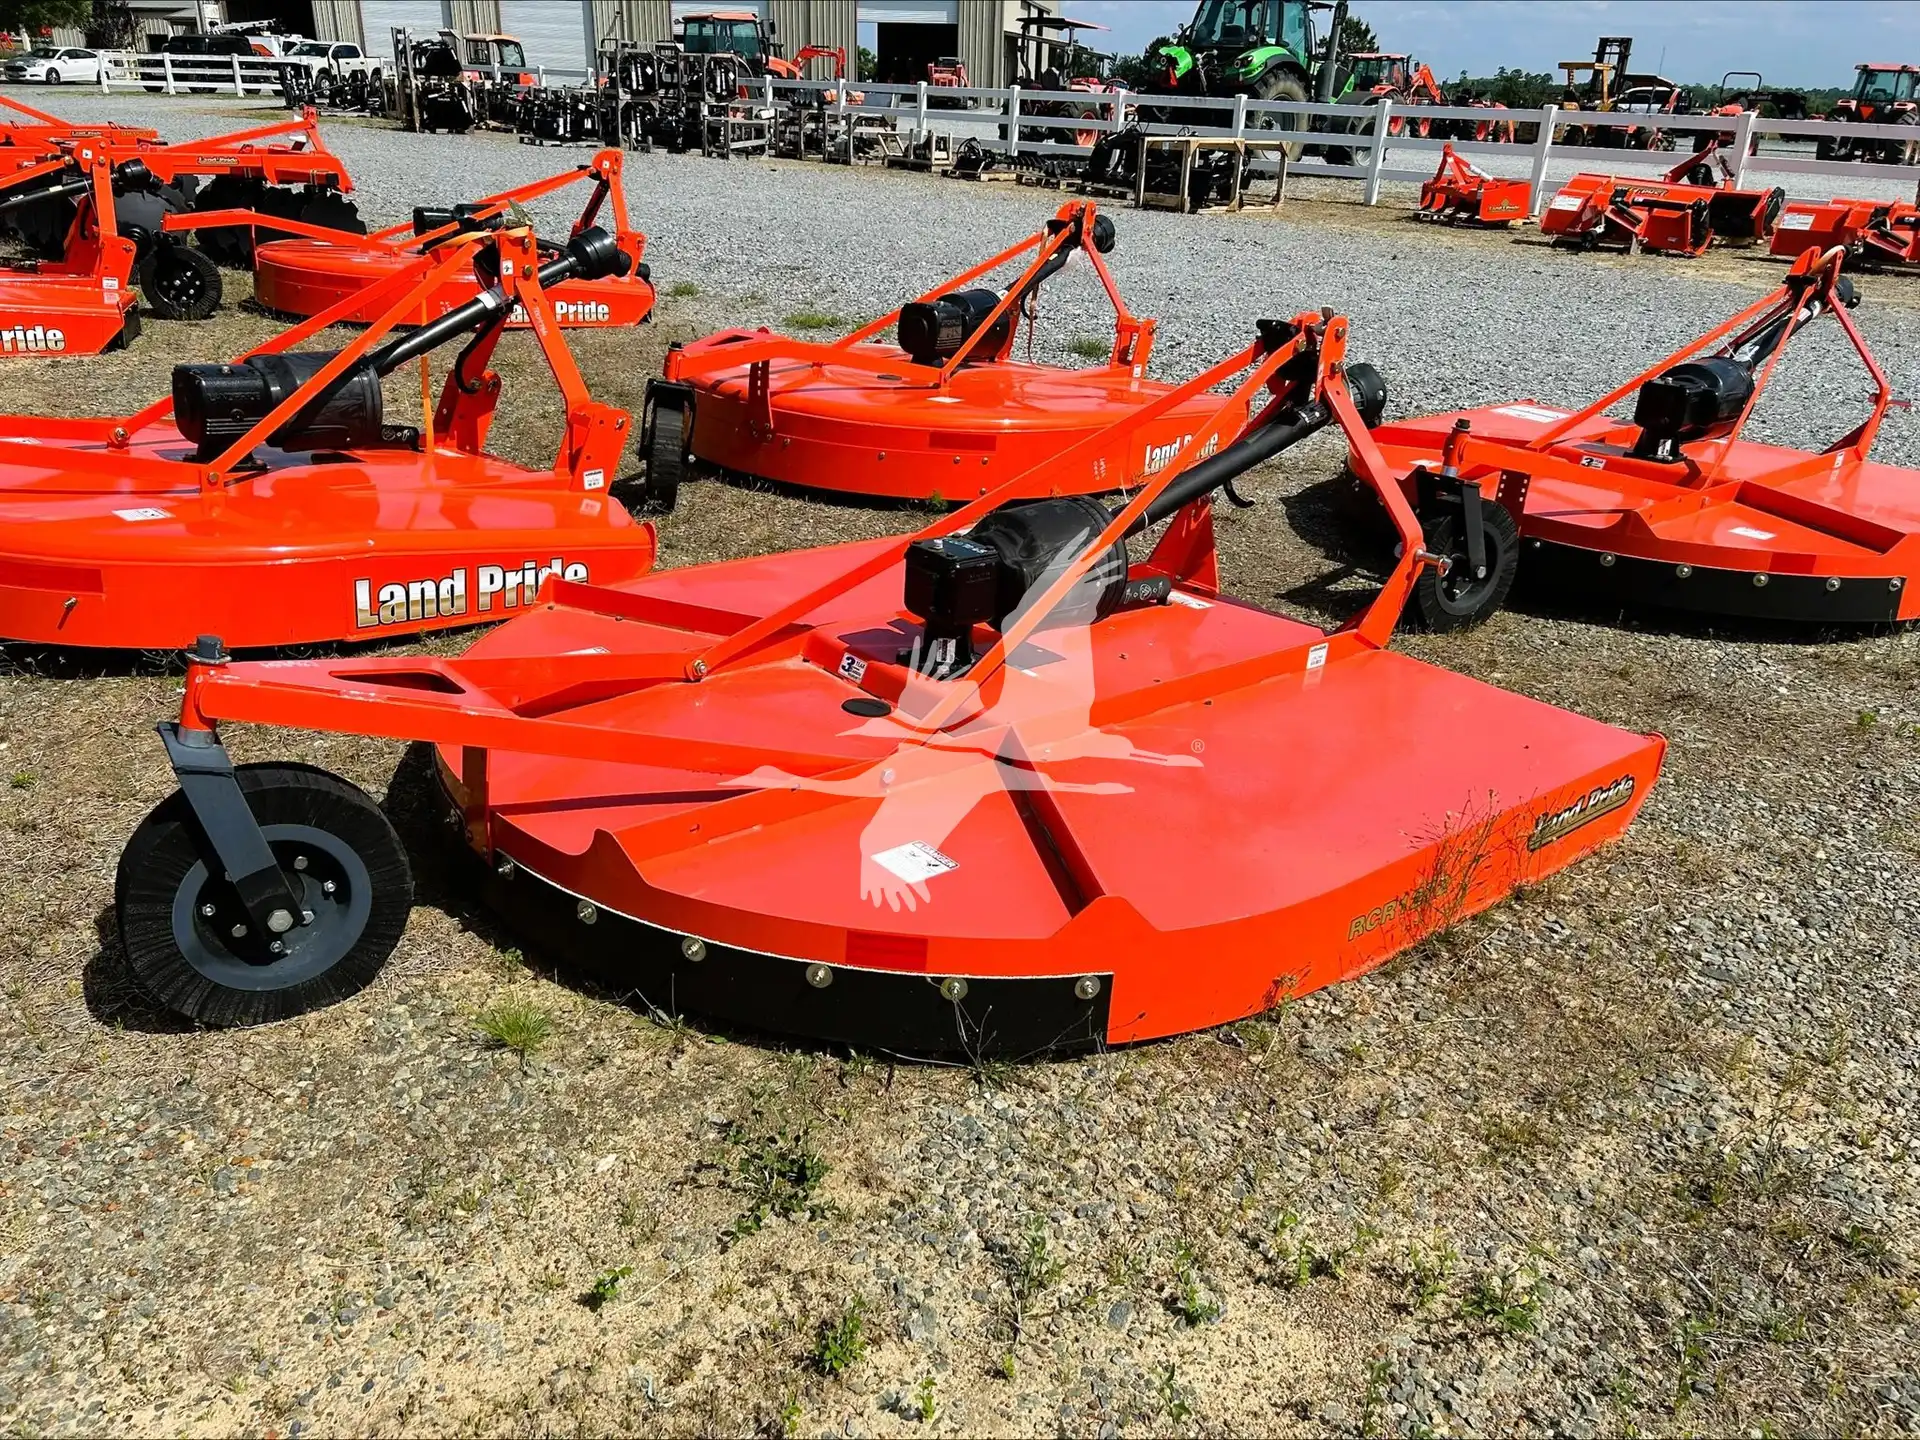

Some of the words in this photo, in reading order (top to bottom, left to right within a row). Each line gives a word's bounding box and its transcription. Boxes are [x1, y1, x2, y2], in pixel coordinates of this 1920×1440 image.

[554, 300, 610, 323] Pride
[0, 324, 66, 353] ride
[354, 567, 467, 628] Land
[841, 656, 856, 673] 3
[1535, 794, 1587, 834] Land
[1587, 774, 1635, 810] Pride
